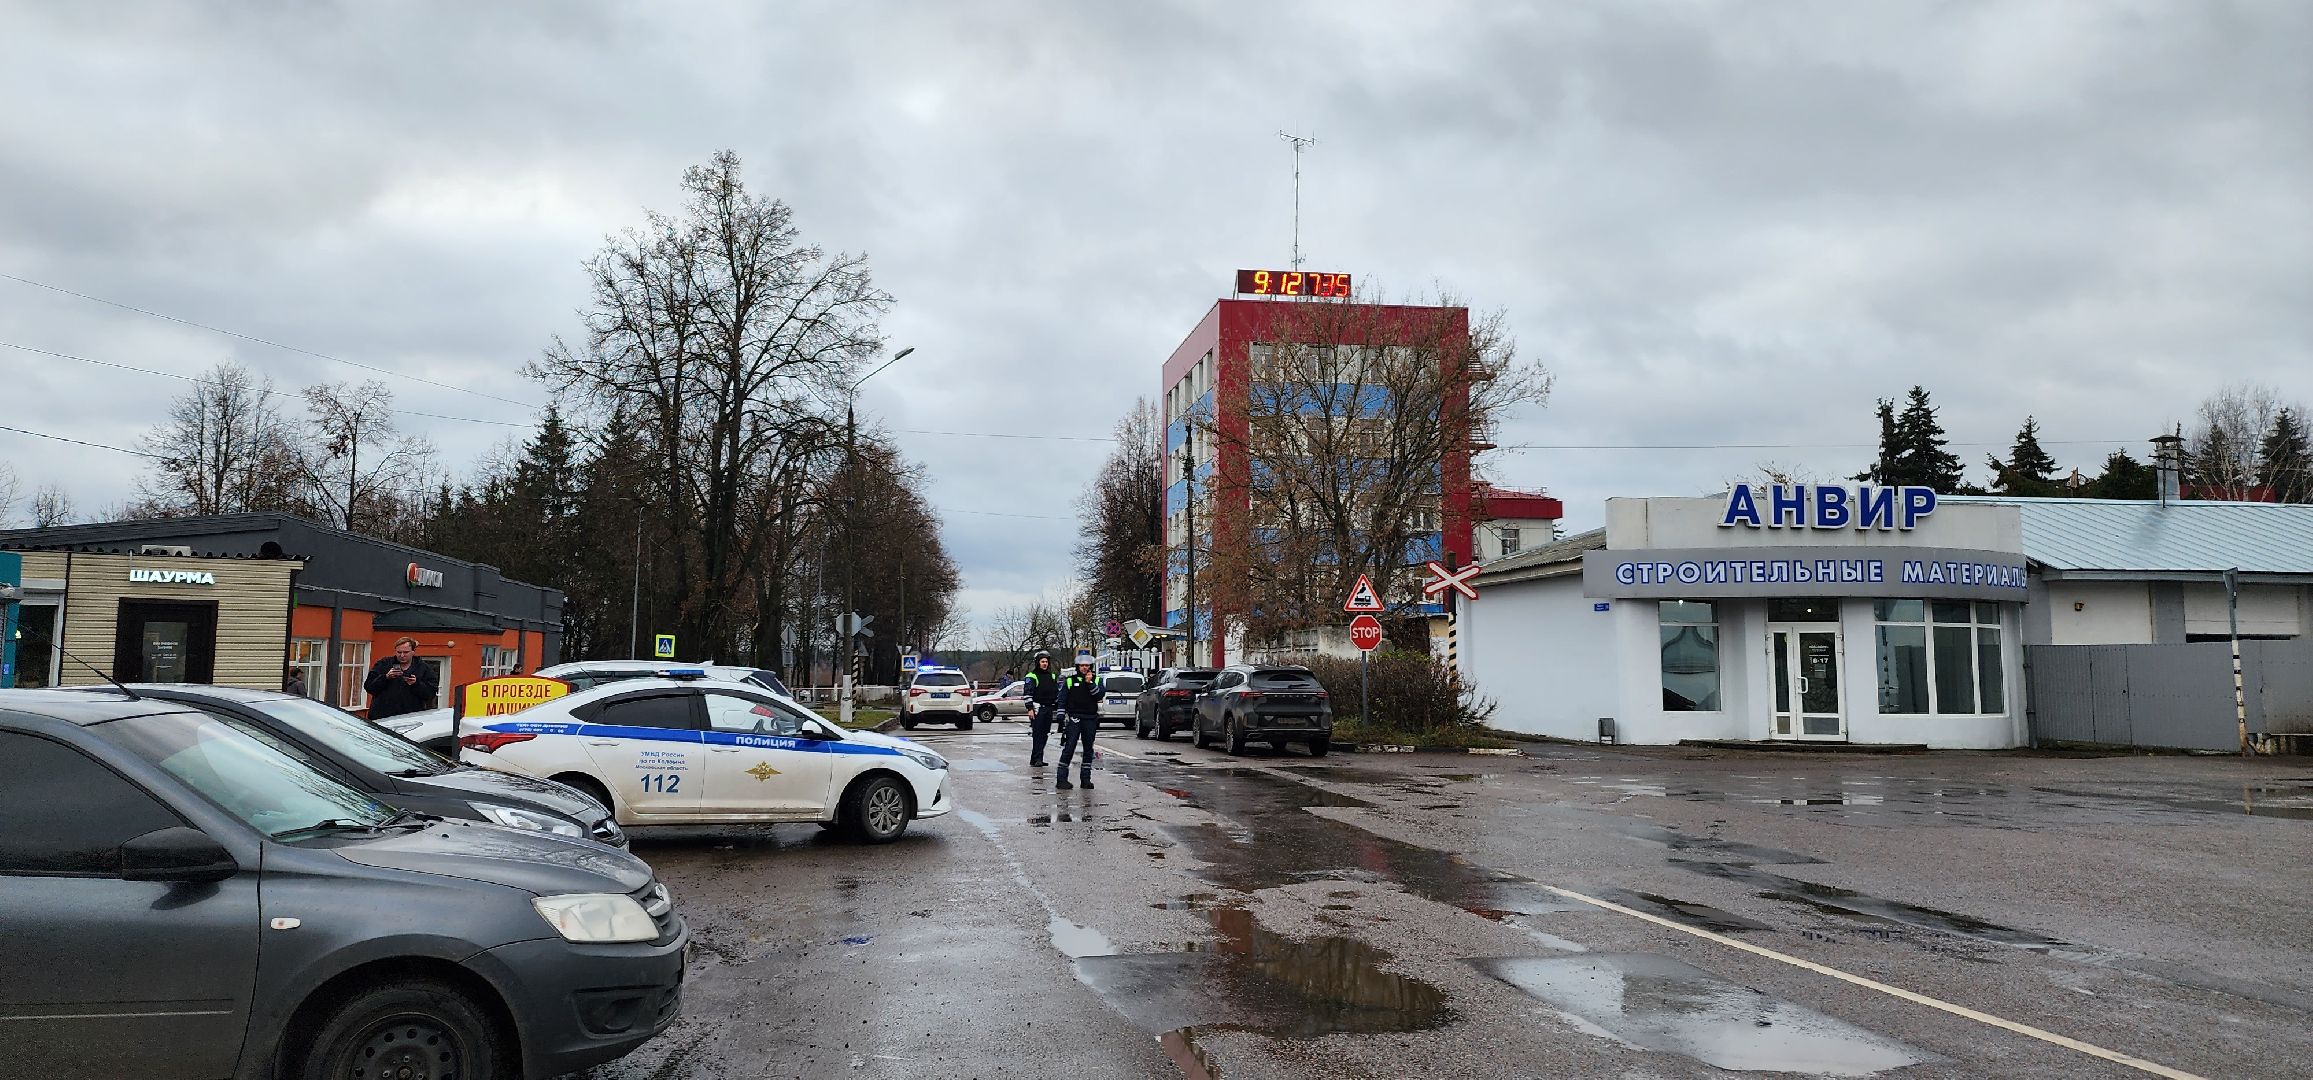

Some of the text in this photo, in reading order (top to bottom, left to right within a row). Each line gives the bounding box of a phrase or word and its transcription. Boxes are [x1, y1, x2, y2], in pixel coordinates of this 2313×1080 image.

[1717, 482, 1938, 531] АНВИР
[129, 569, 216, 585] ШАУРМА
[1616, 560, 1884, 585] СТРОИТЕЛЬНЫЕ
[1352, 627, 1379, 638] STOP
[481, 684, 552, 699] В ПРОЕЗДЕ
[486, 702, 539, 716] МАШИ
[735, 736, 796, 749] ПОЛИЦИЯ
[640, 774, 680, 792] 112
